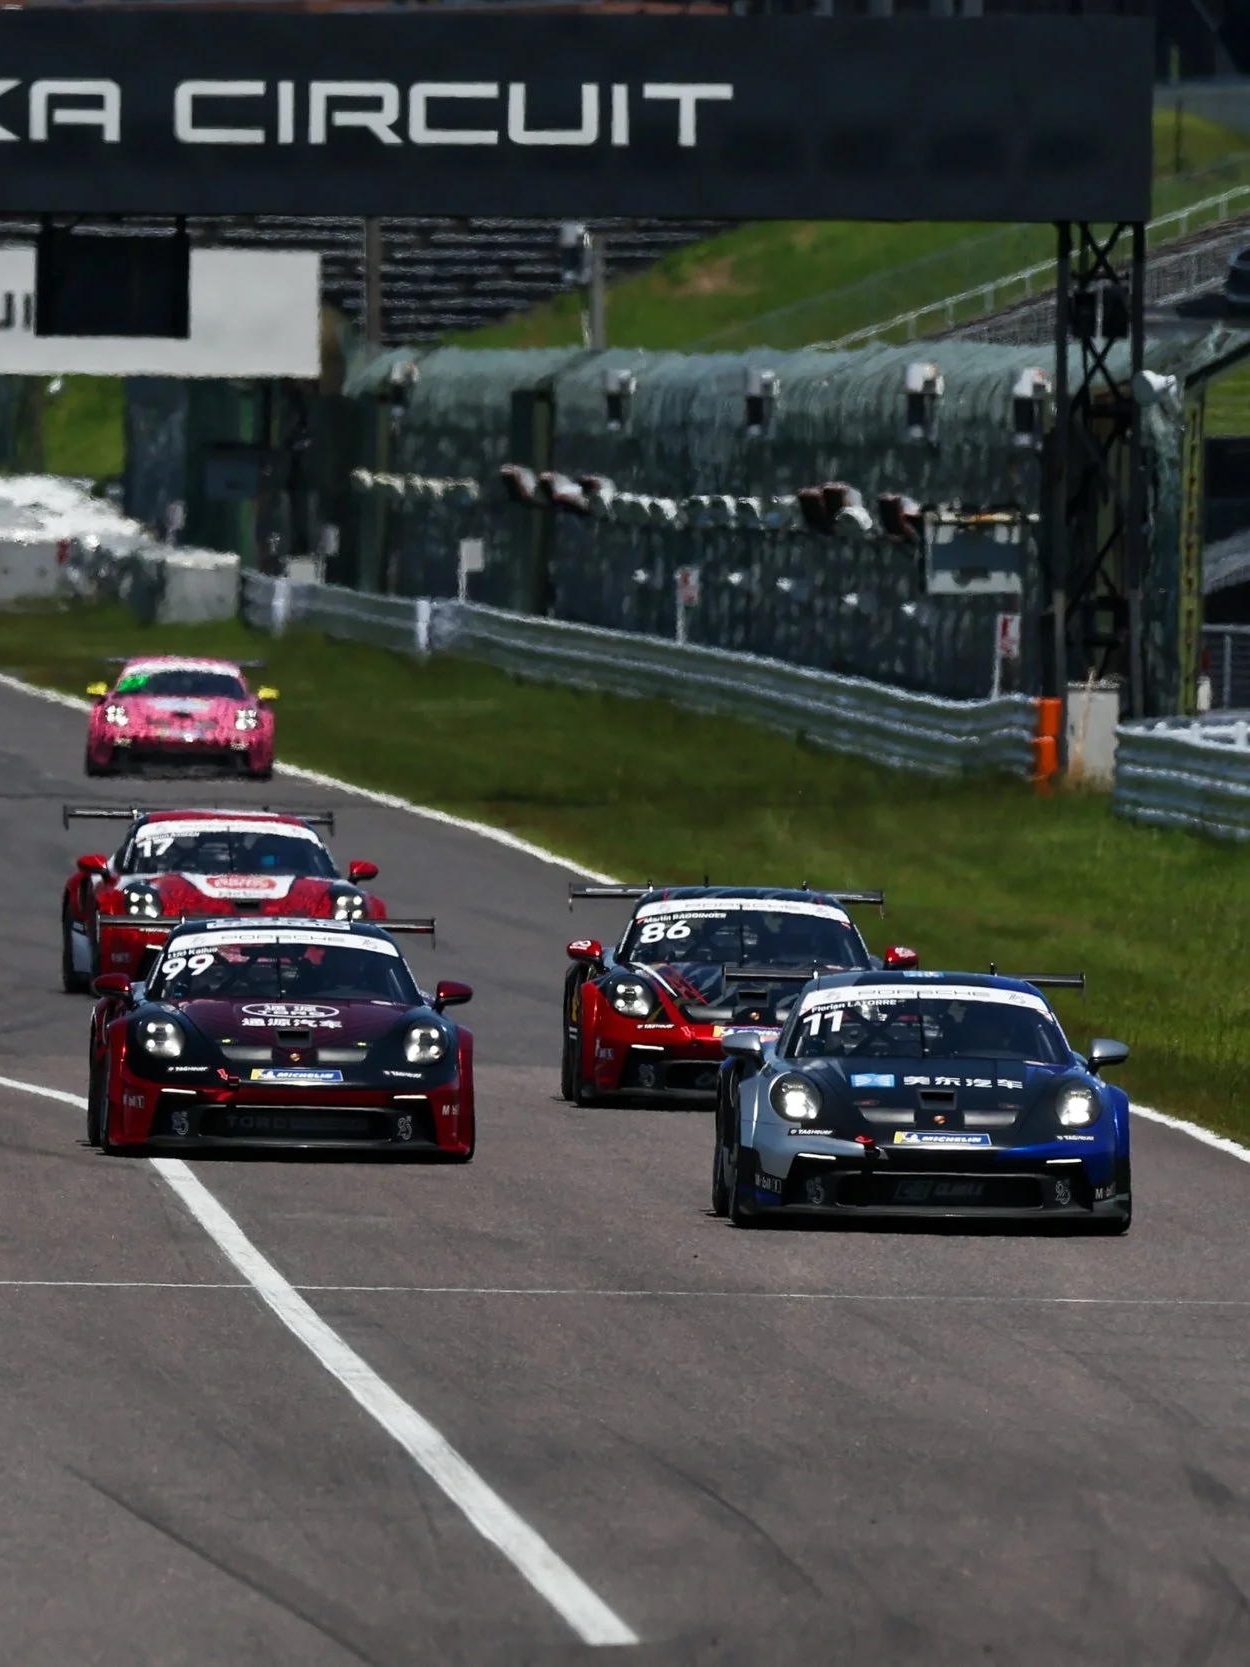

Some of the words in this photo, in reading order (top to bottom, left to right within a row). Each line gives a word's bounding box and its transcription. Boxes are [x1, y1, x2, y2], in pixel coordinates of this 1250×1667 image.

[173, 80, 734, 148] CIRCUIT
[137, 838, 175, 858] 17
[221, 934, 346, 942] PORSCHE
[640, 920, 691, 944] 86
[162, 953, 215, 981] 99
[857, 989, 991, 997] PORSCHE
[811, 1002, 846, 1013] Florian
[847, 999, 898, 1008] LATORRE
[802, 1010, 844, 1036] 11
[921, 1135, 982, 1143] MICHELIN
